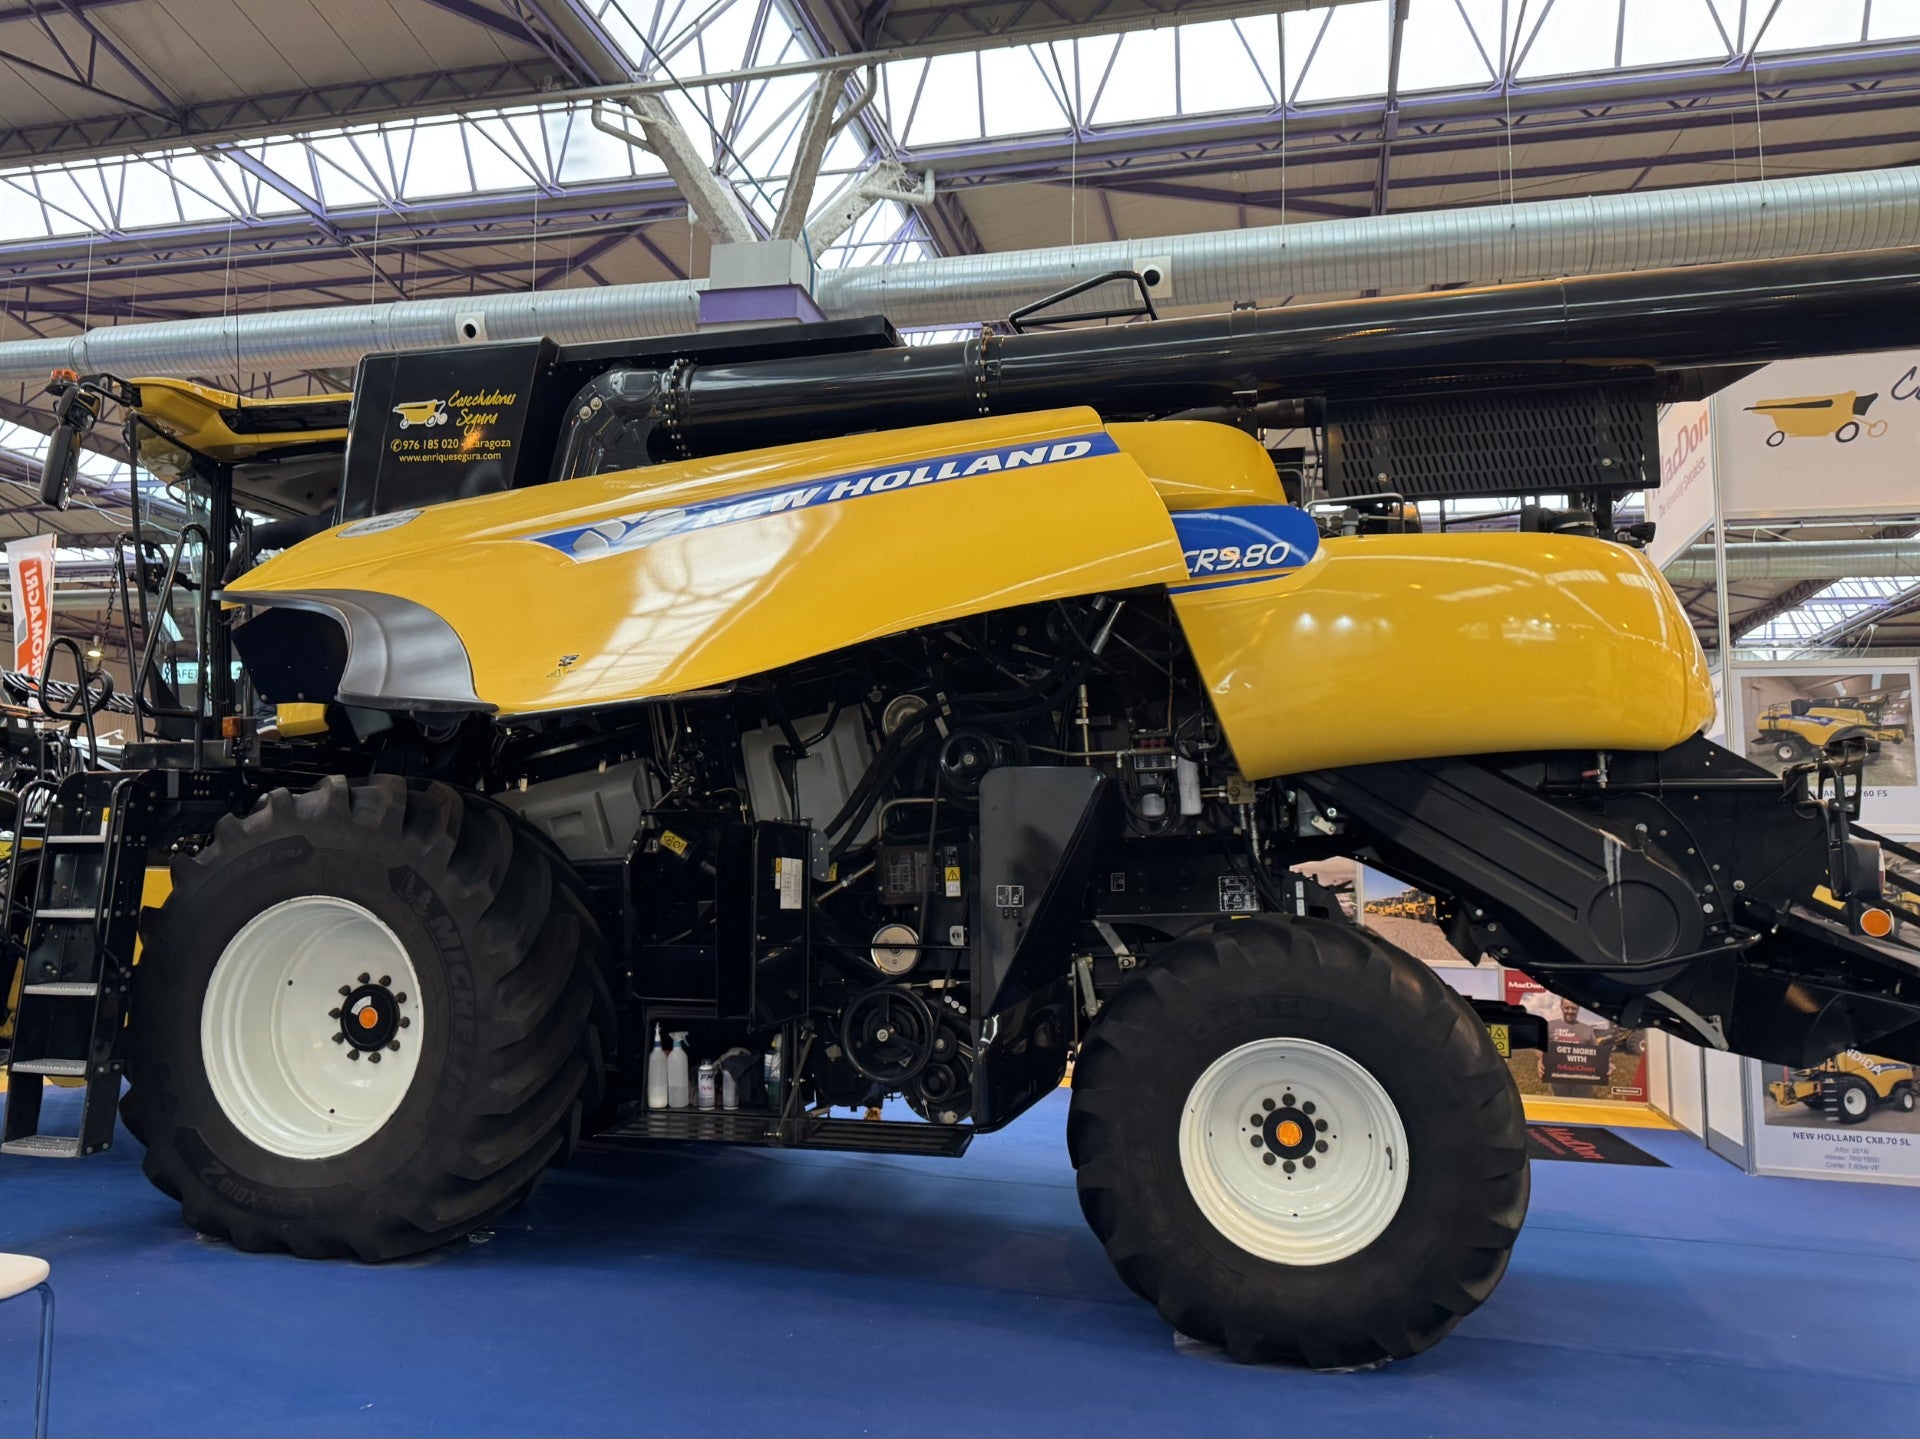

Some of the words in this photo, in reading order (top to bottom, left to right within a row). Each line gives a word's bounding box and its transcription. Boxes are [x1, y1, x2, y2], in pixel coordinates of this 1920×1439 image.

[448, 389, 517, 408] Cosechadoras
[455, 408, 499, 436] Segura
[402, 439, 420, 450] 976
[423, 439, 439, 449] 185
[441, 438, 459, 449] 020
[468, 438, 511, 450] aragoza
[399, 452, 501, 463] www.enriquesegura.com
[692, 487, 818, 529] NEW
[828, 440, 1092, 501] HOLLAND
[1183, 542, 1290, 573] CR9.80
[1556, 1046, 1572, 1054] GET
[1566, 1055, 1587, 1063] WITH
[1792, 1131, 1814, 1140] NEW
[1817, 1132, 1863, 1143] HOLLAND
[1900, 1137, 1911, 1146] SL
